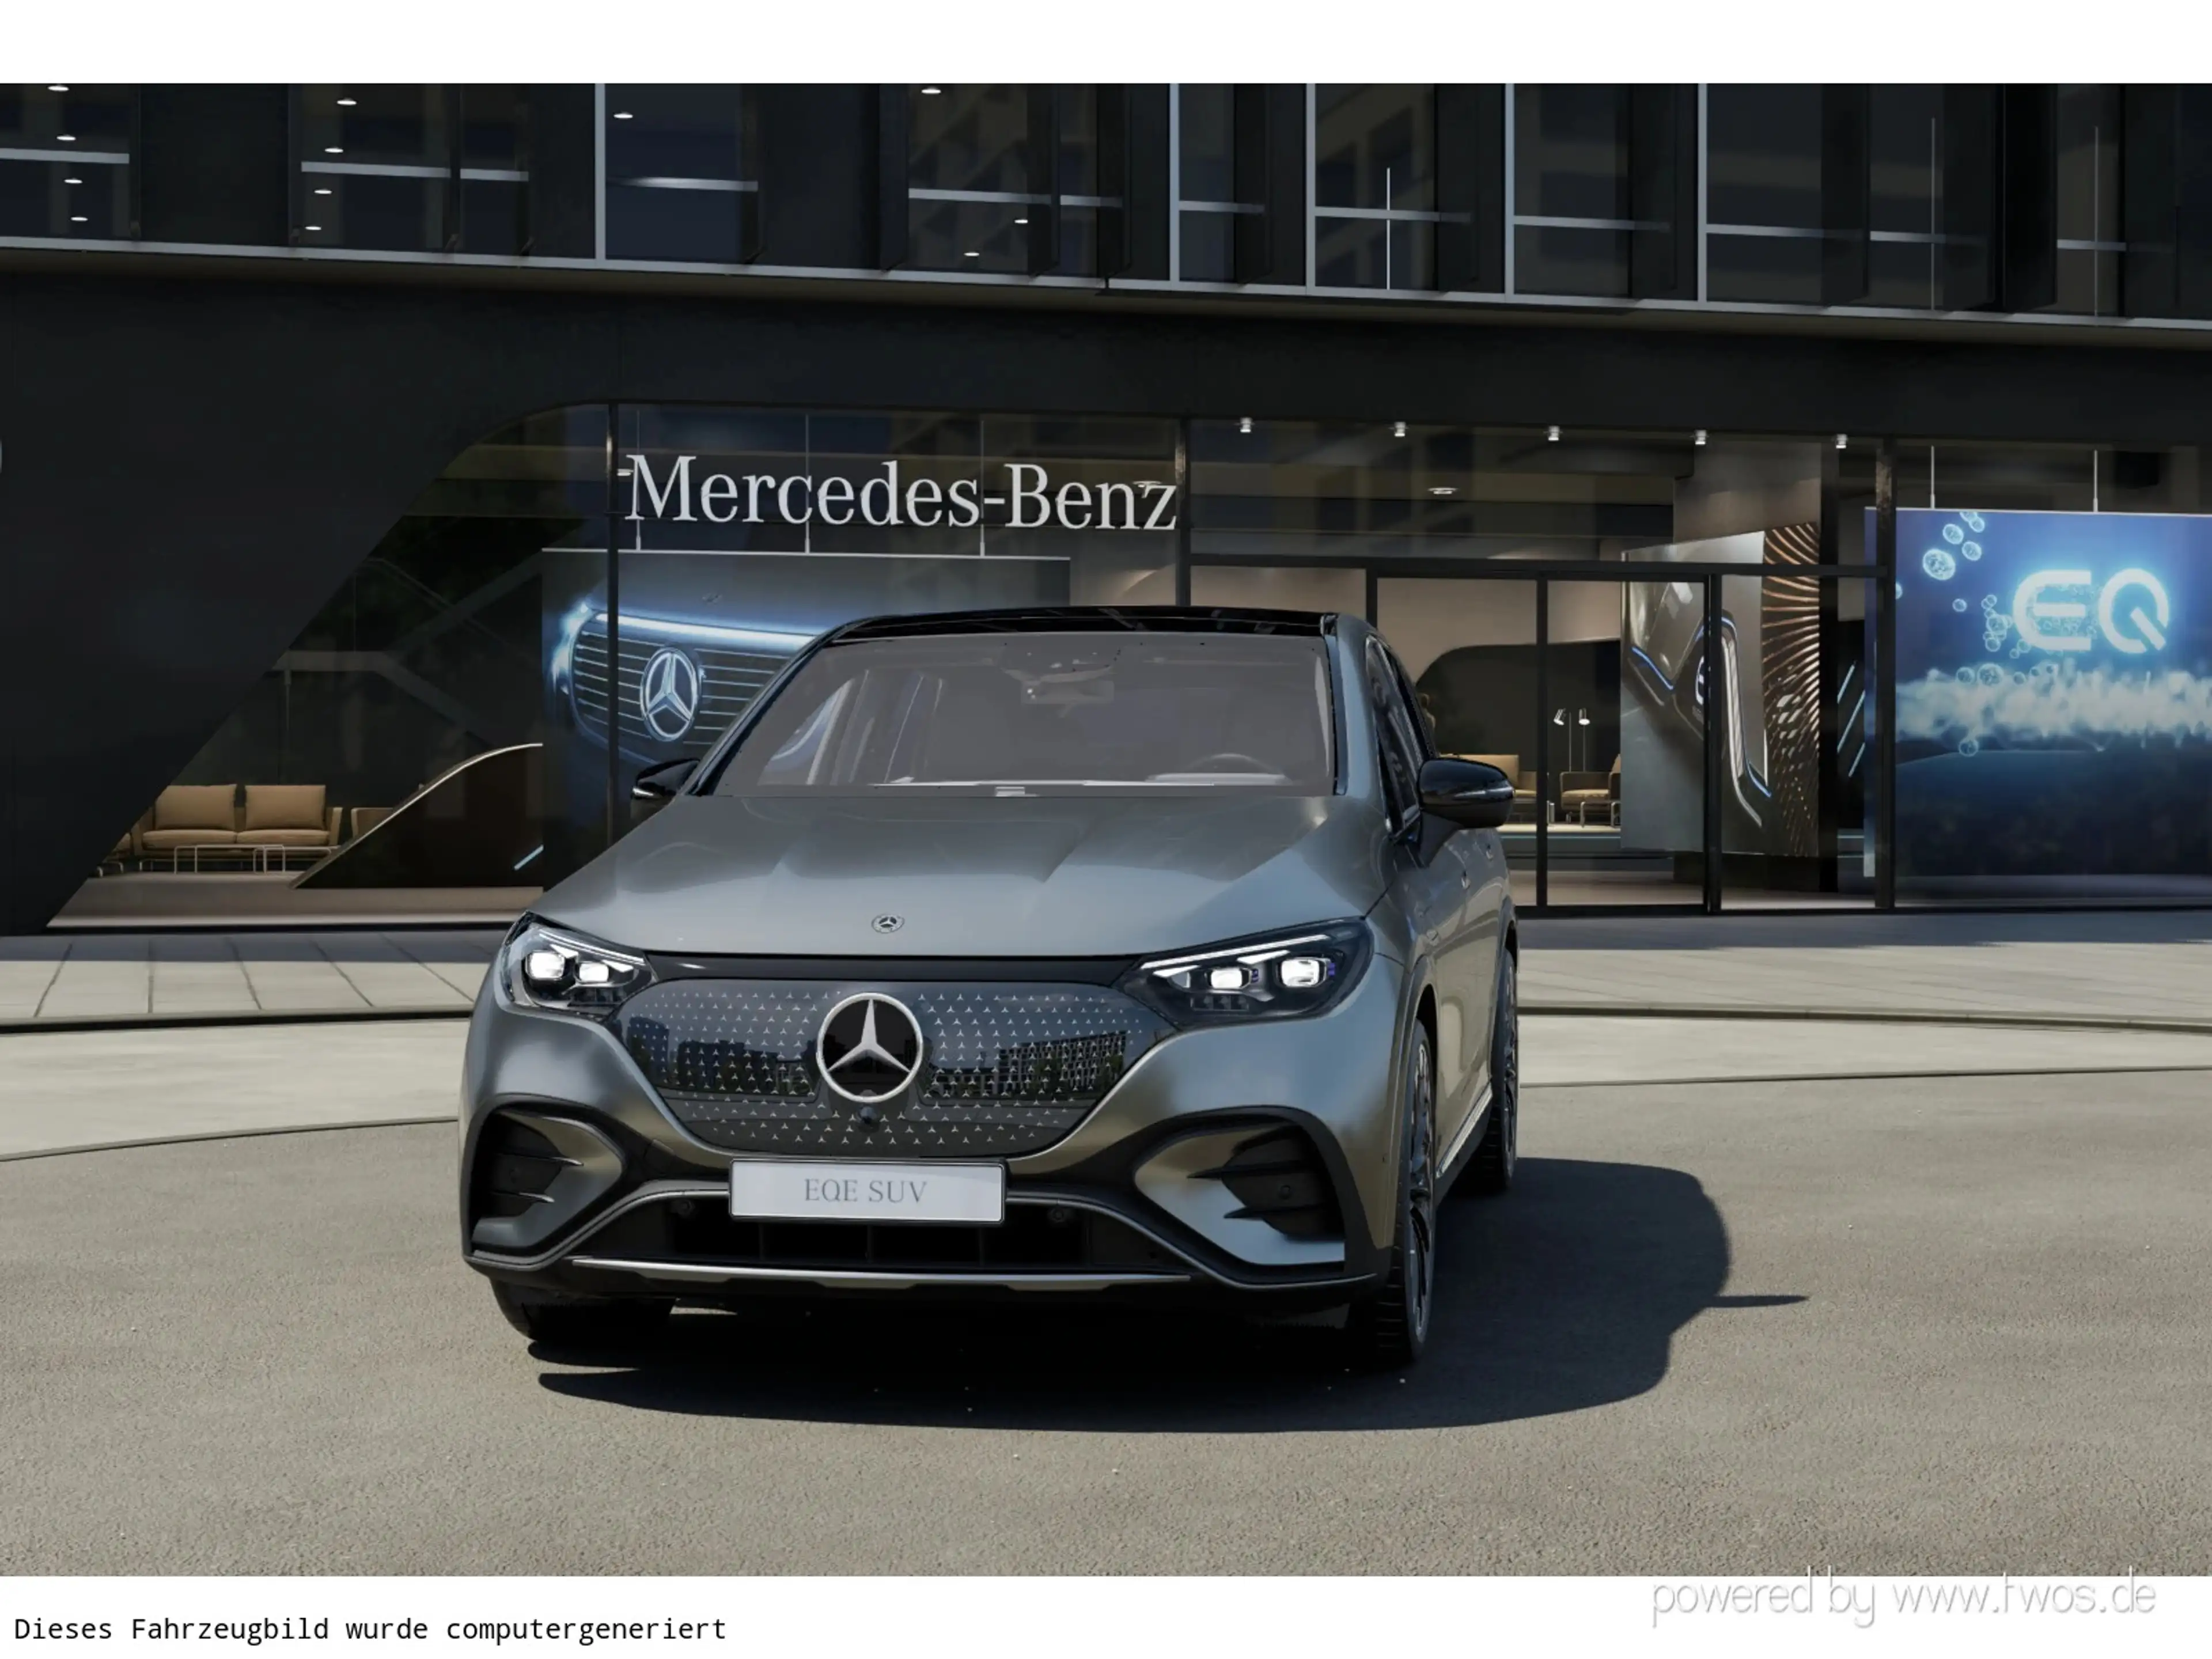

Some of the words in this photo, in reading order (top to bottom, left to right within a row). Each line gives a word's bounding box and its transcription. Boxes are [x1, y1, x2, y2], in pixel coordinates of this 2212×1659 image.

[625, 454, 1177, 530] Mercedes-Benz
[2013, 568, 2169, 654] EQ
[804, 1177, 858, 1202] EQE
[868, 1180, 928, 1204] SUV
